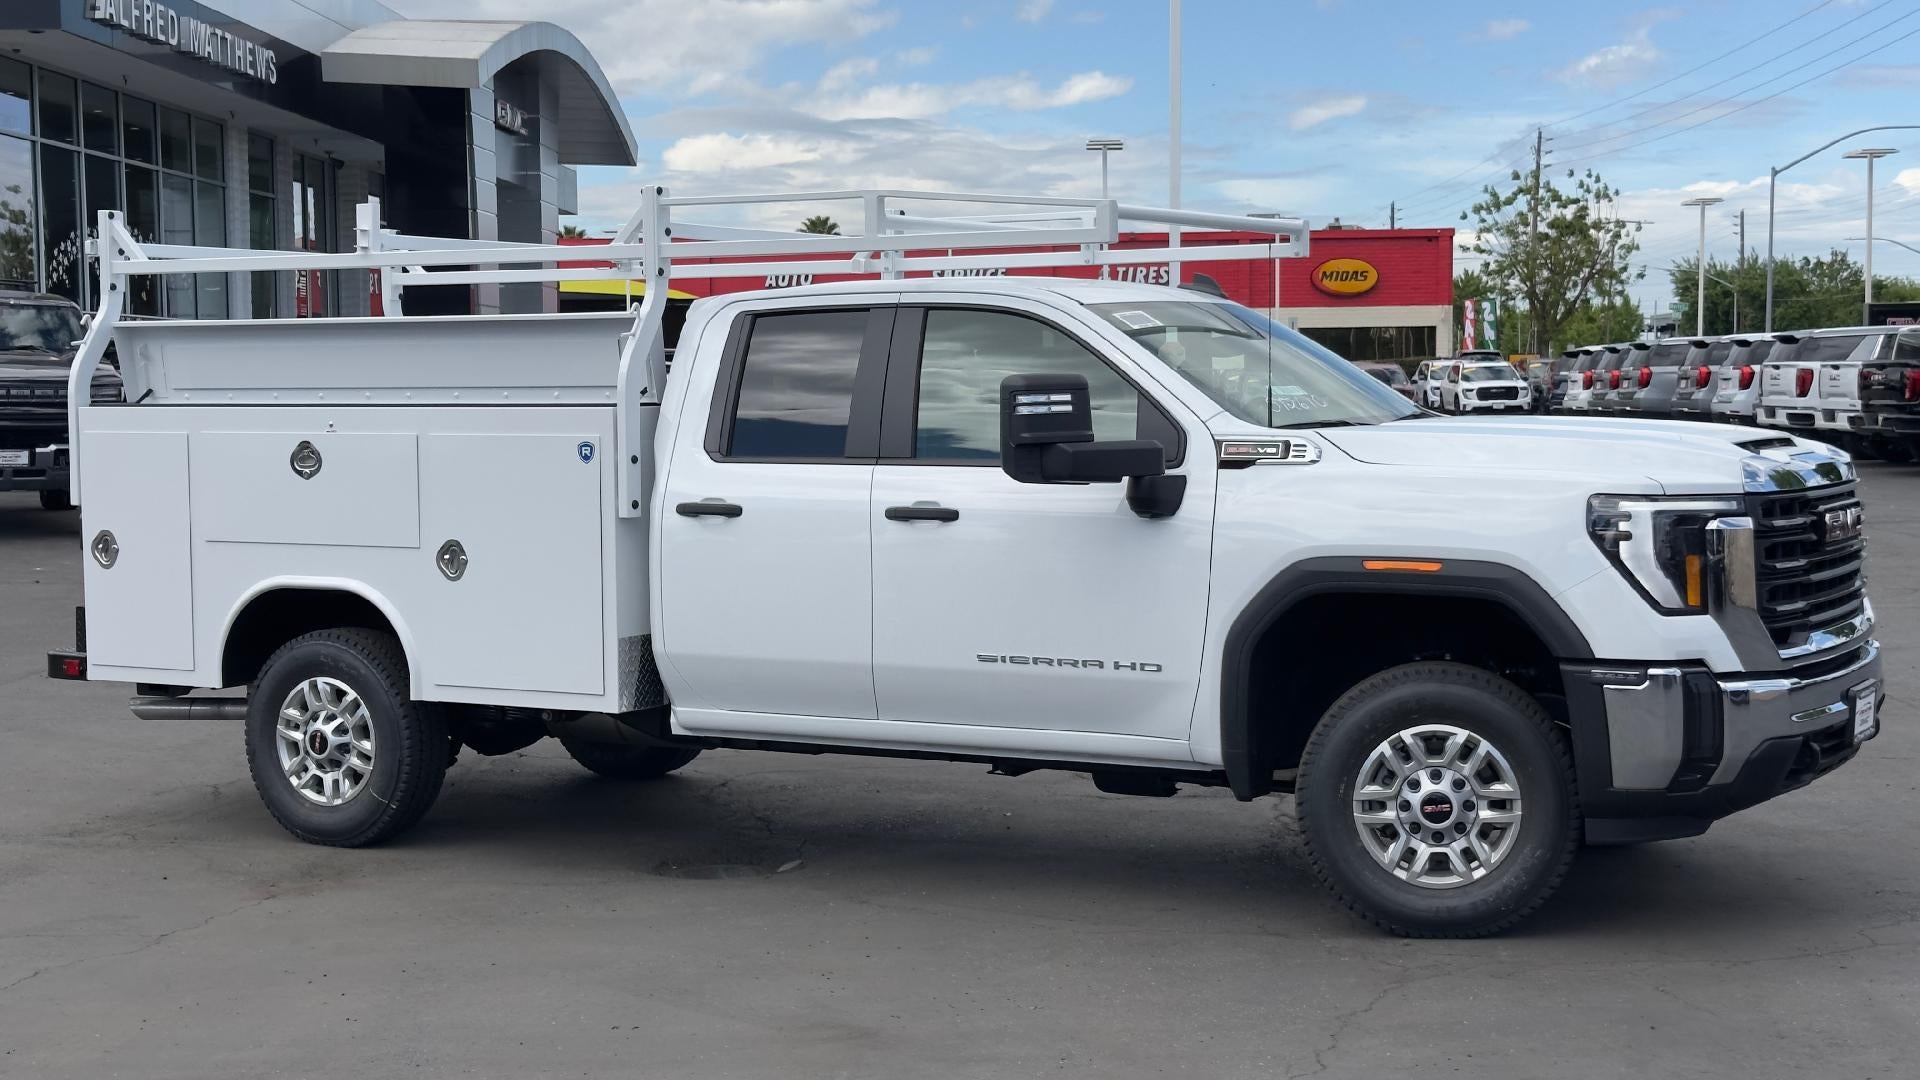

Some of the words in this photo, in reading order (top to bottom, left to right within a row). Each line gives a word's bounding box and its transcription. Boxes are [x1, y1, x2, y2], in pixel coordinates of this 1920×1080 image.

[104, 0, 178, 46] ALFRED
[189, 17, 277, 84] MATTHEWS
[1116, 265, 1169, 284] TIRES
[1320, 270, 1369, 282] MIDAS
[976, 653, 1104, 669] SIERRA
[1113, 660, 1162, 673] HD
[1423, 803, 1451, 813] GMC
